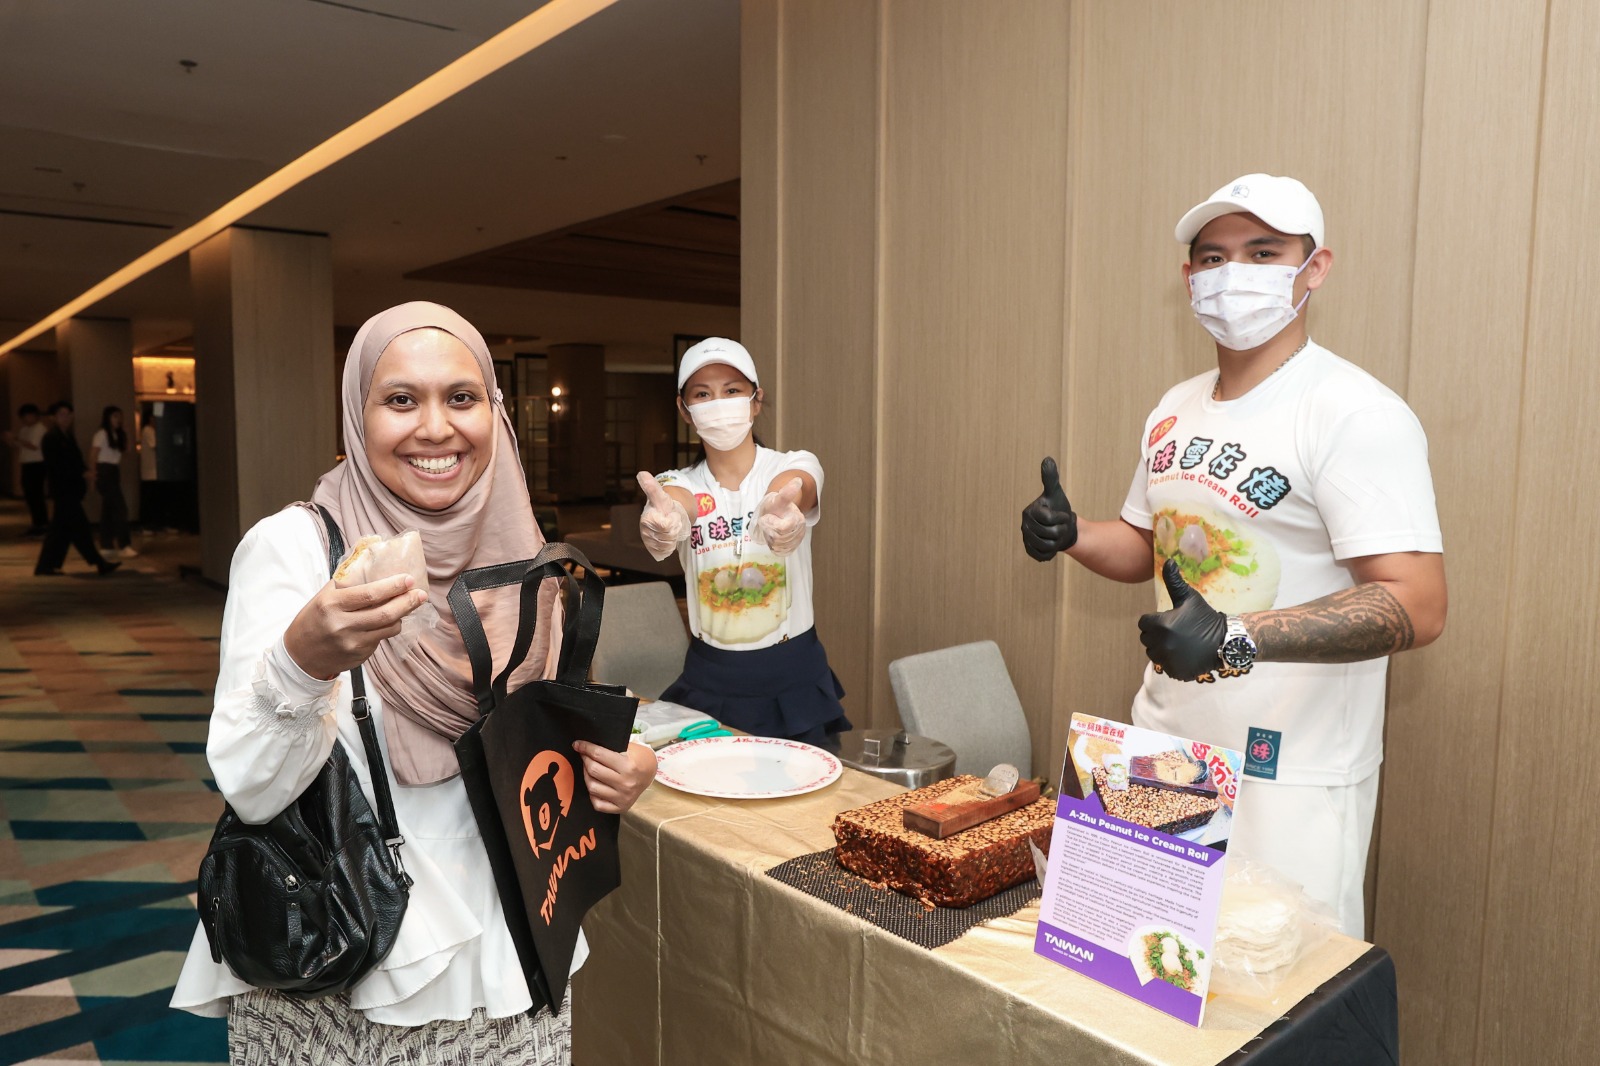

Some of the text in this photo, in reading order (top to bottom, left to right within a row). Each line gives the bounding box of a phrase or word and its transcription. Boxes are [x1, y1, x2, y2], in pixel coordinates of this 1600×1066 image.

[1181, 470, 1196, 481] Ice
[1197, 474, 1228, 498] Cream
[1229, 494, 1259, 518] Roll
[1069, 810, 1209, 861] A-Zhu Peanut Ice Cream Roll
[540, 827, 597, 926] TAIWAN
[1044, 932, 1094, 962] TAIWAN
